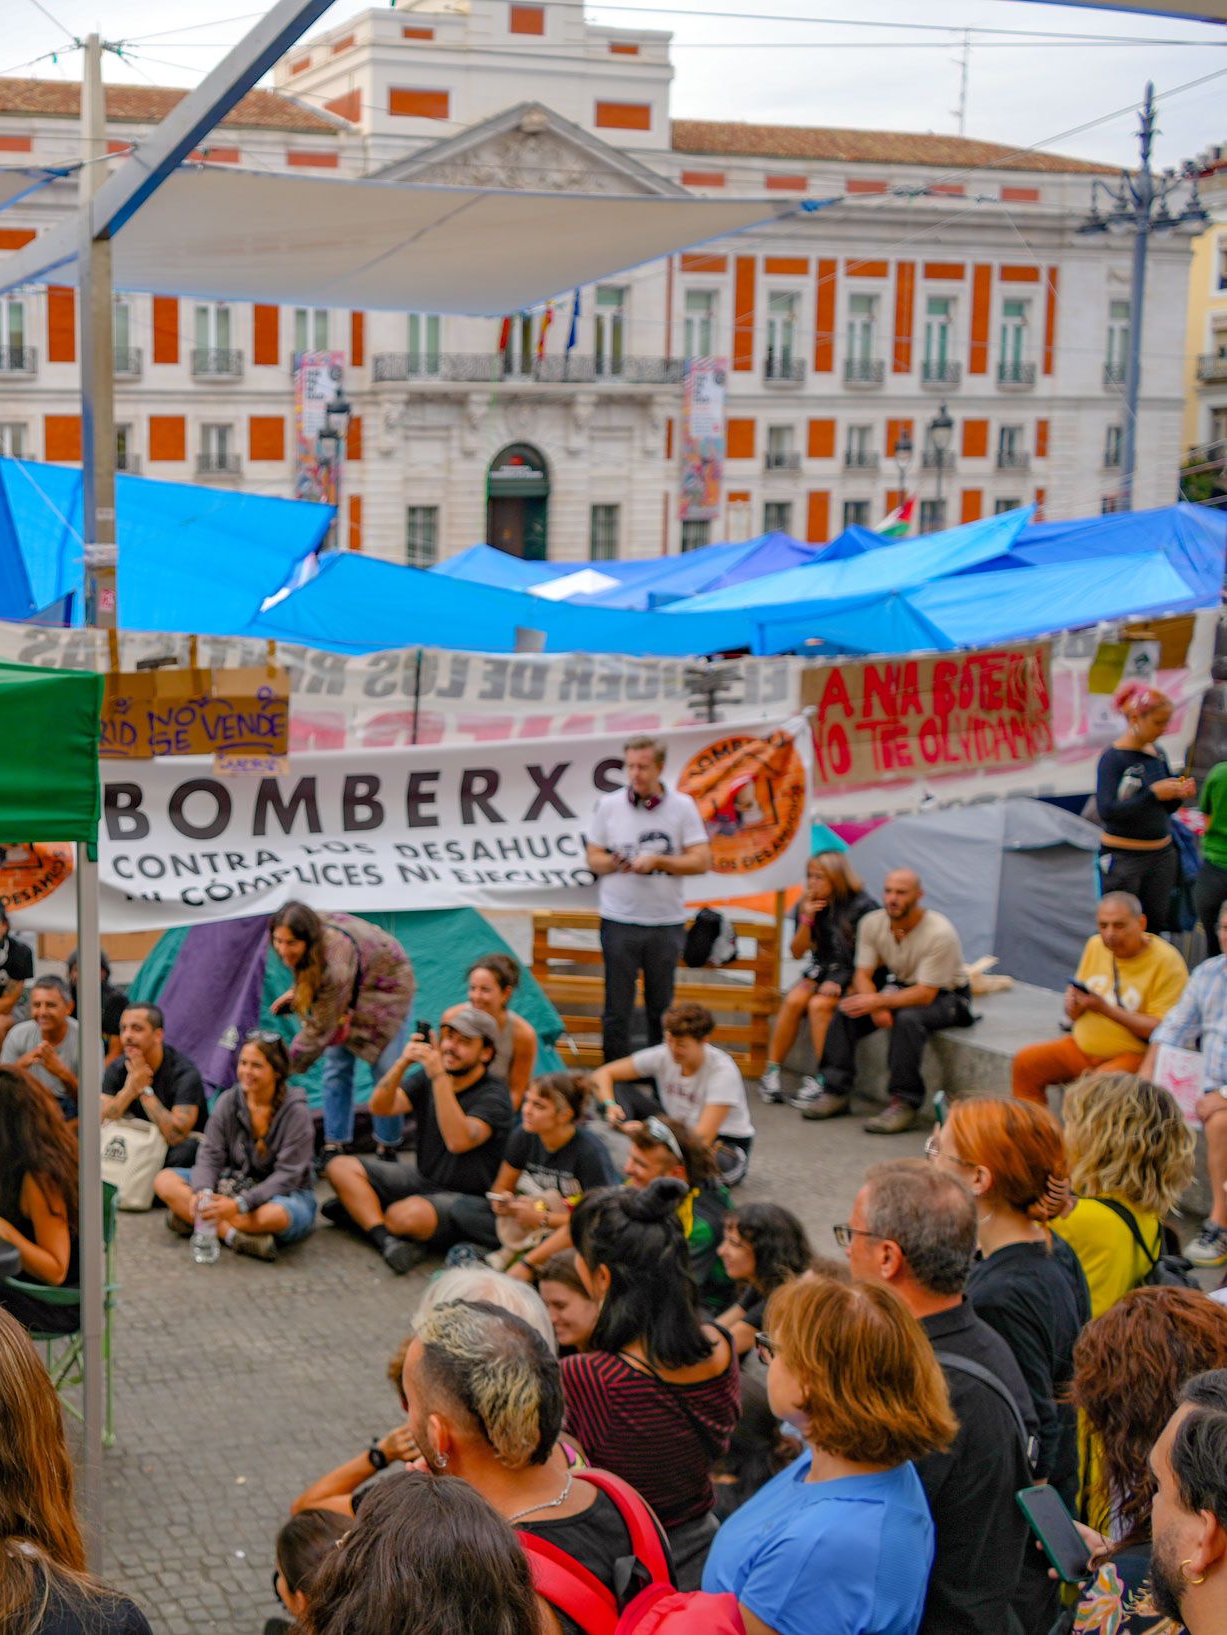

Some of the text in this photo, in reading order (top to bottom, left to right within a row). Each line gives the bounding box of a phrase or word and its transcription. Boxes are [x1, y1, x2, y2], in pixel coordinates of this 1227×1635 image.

[148, 705, 197, 733] NO
[201, 711, 286, 742] VENDE
[855, 719, 915, 771] TE
[111, 848, 281, 880] CONTRA
